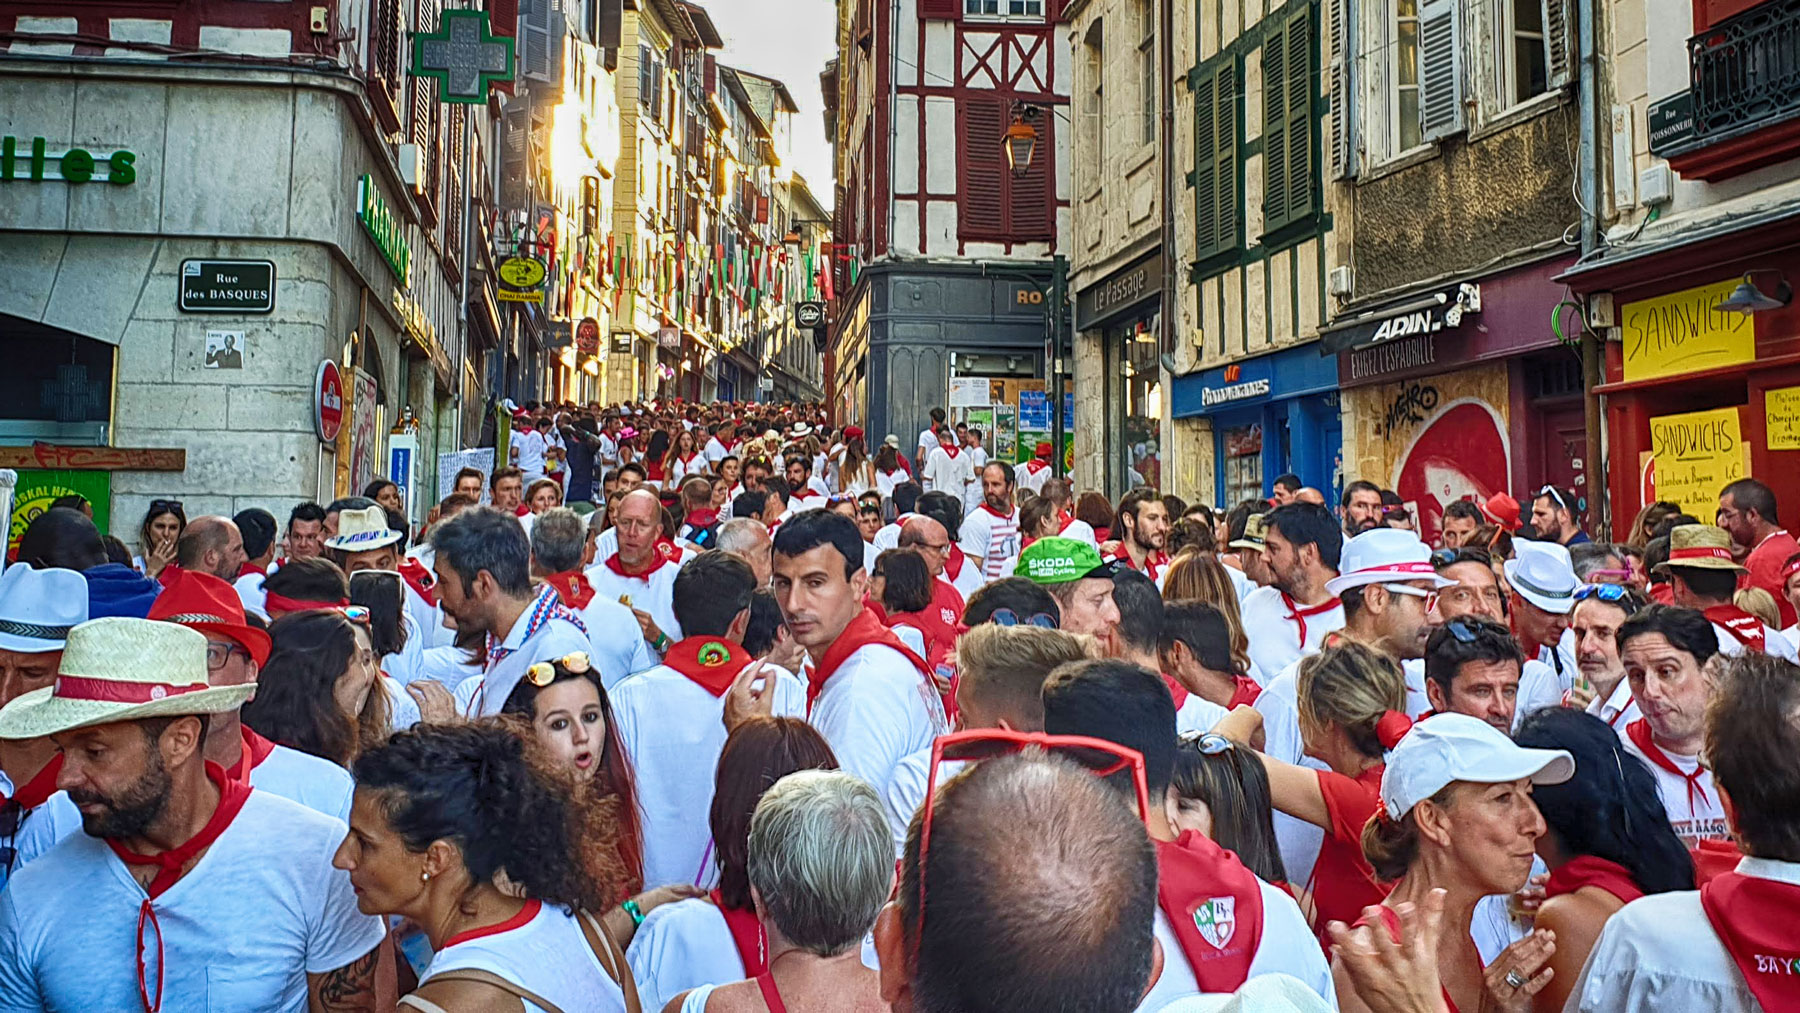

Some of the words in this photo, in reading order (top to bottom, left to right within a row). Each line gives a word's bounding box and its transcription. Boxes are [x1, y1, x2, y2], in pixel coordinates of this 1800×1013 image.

[1665, 110, 1677, 120] Rue
[216, 273, 239, 284] Rue
[185, 288, 205, 299] des
[210, 289, 268, 301] BASQUES
[1093, 288, 1104, 312] Le
[1106, 269, 1144, 306] Passage
[1351, 350, 1378, 380] EXIGEZ
[1379, 336, 1435, 374] L'ESPADRILLE
[1654, 419, 1734, 458] SANDWICHS
[14, 486, 49, 508] USKAL
[1675, 824, 1693, 834] AYS
